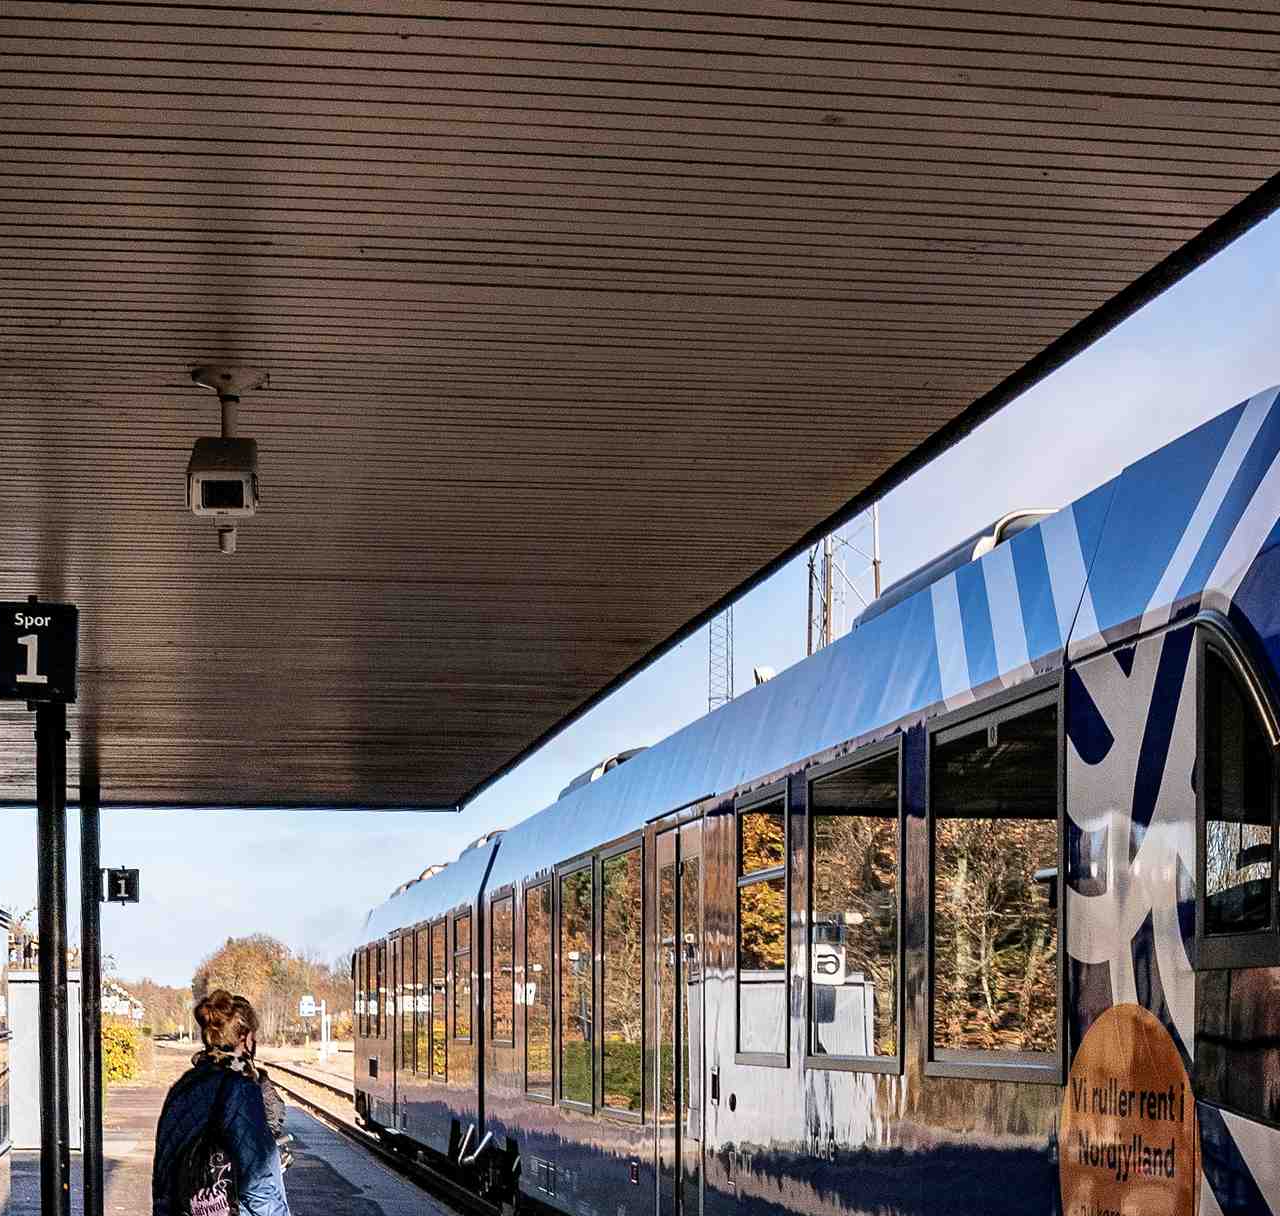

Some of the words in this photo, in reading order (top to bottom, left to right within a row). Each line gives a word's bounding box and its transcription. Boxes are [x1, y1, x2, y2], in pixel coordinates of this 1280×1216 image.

[14, 612, 51, 628] Spor
[16, 634, 48, 684] 1
[1072, 1077, 1087, 1114] Vi
[1092, 1079, 1136, 1119] ruller
[1139, 1086, 1175, 1122] rent
[1078, 1132, 1175, 1182] Nordjylland
